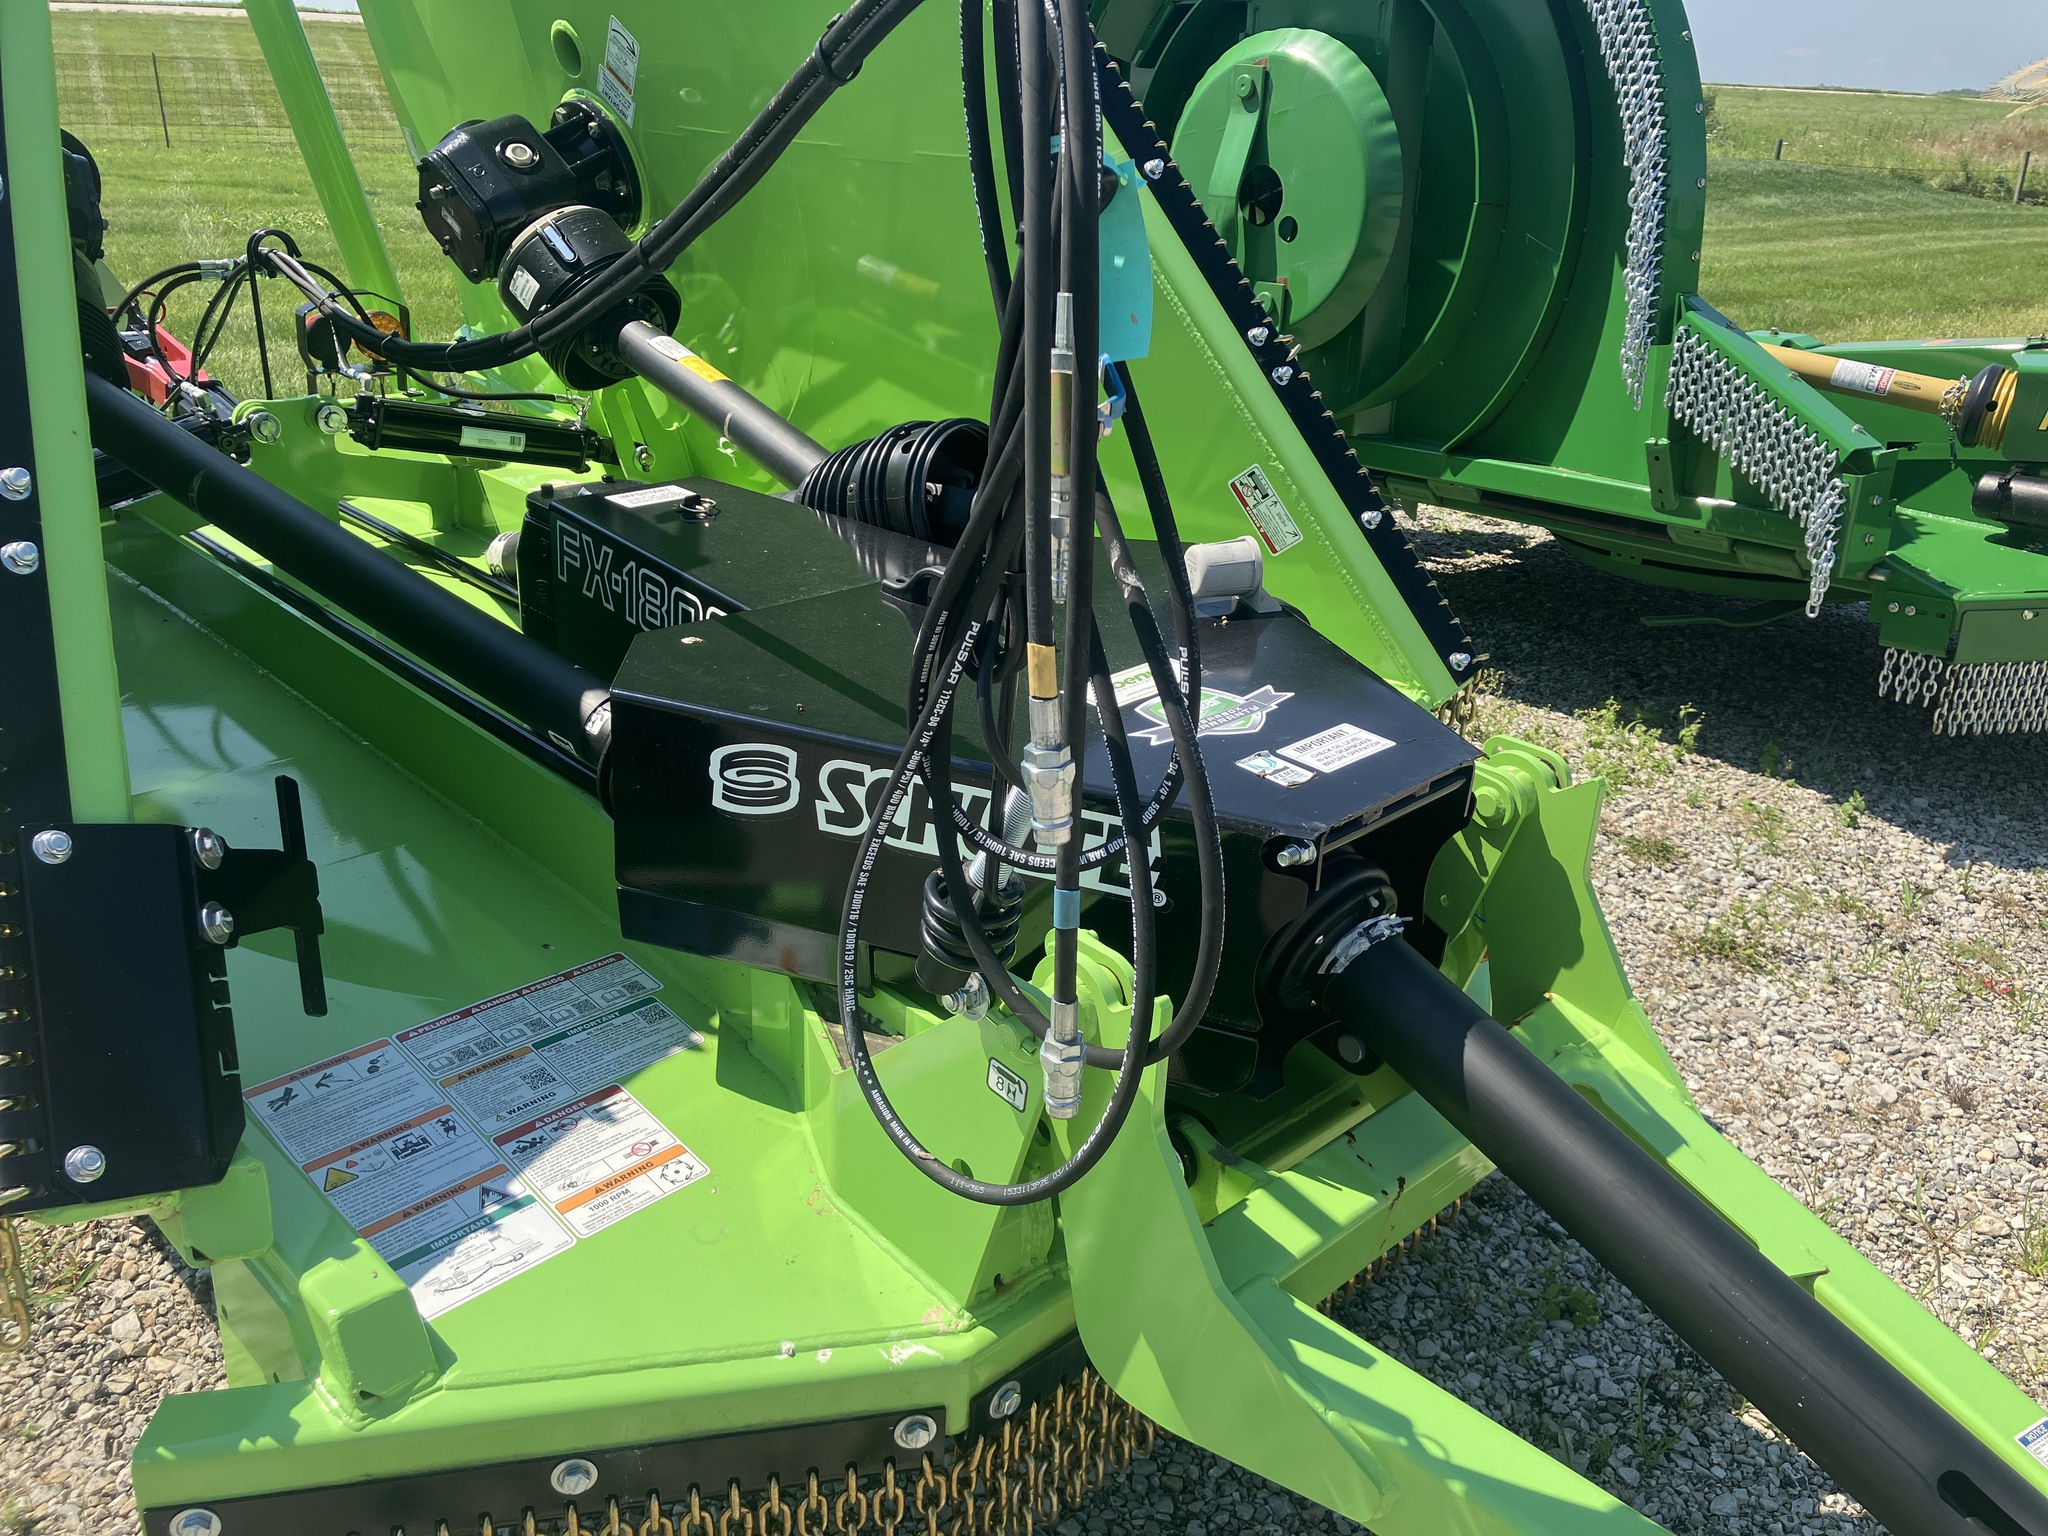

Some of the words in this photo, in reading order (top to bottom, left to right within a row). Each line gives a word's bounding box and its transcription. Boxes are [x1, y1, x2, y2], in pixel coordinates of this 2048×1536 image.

[946, 620, 981, 685] PULSAR
[1292, 728, 1351, 754] IMPORTANT
[899, 770, 914, 784] PSI
[889, 788, 904, 804] 400
[881, 804, 897, 821] BAR
[876, 821, 890, 835] WP
[862, 837, 881, 871] EXCEEDS
[978, 831, 1008, 857] 100R16
[1088, 846, 1108, 862] BAR
[1107, 837, 1127, 853] 400
[1008, 850, 1027, 864] SAE
[856, 871, 870, 887] SAE
[849, 888, 865, 921] 100R16
[845, 927, 857, 960] 100R19
[580, 956, 616, 973] GEFAHR
[530, 976, 565, 991] PERIGO
[480, 992, 520, 1010] DANGER
[417, 1014, 461, 1033] PELIGRO
[566, 1011, 620, 1036] IMPORTANT
[299, 1054, 351, 1077] WARNING
[465, 1054, 515, 1077] WARNING
[996, 1076, 1004, 1091] 8
[506, 1091, 557, 1116] WARNING
[542, 1101, 588, 1122] DANGER
[870, 1088, 893, 1121] ABRASION
[360, 1122, 412, 1149] WARNING
[889, 1120, 905, 1139] MADE
[902, 1136, 912, 1146] IN
[602, 1161, 655, 1190] WARNING
[412, 1184, 467, 1212] WARNING
[588, 1198, 611, 1213] 1000
[609, 1188, 632, 1203] RPM
[430, 1216, 492, 1251] IMPORTANT
[2025, 1424, 2048, 1443] NOTICE
